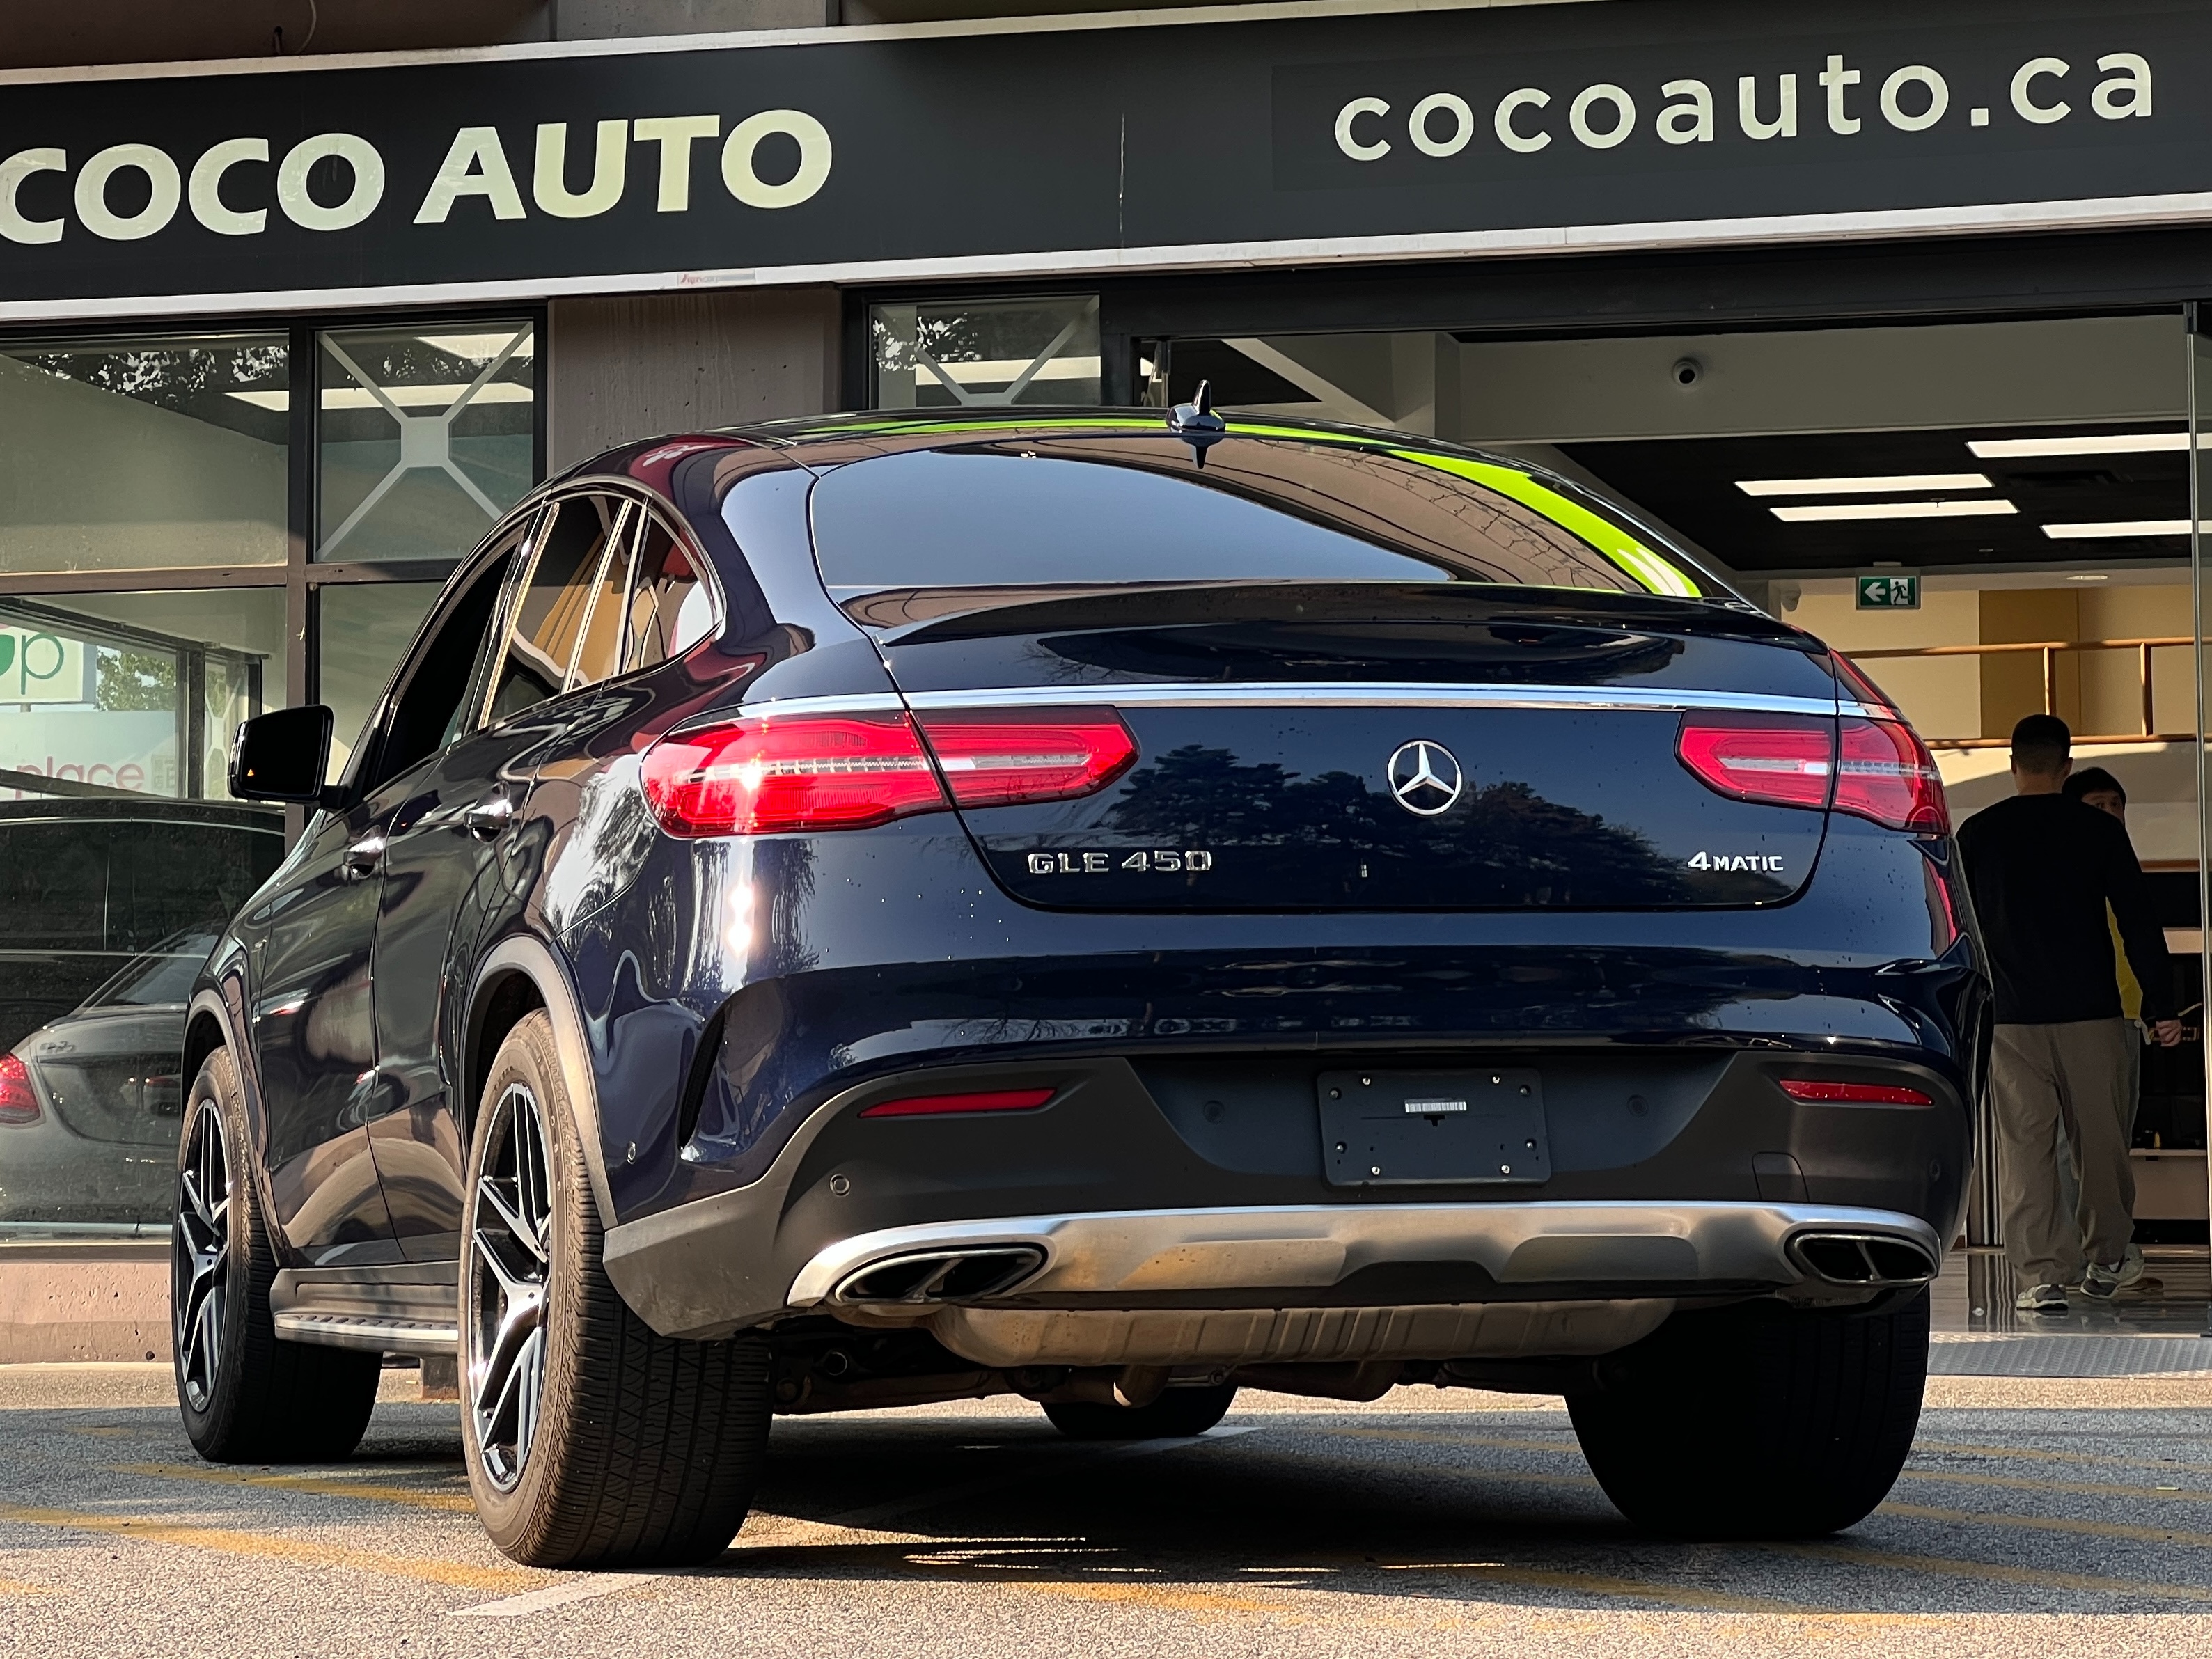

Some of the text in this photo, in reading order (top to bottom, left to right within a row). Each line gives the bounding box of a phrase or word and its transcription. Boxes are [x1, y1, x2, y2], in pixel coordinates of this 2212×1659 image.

[1334, 52, 2153, 161] cocoauto.ca
[0, 109, 833, 244] COCO AUTO
[1027, 849, 1212, 874] GLE 450
[1686, 851, 1784, 872] 4MATIC
